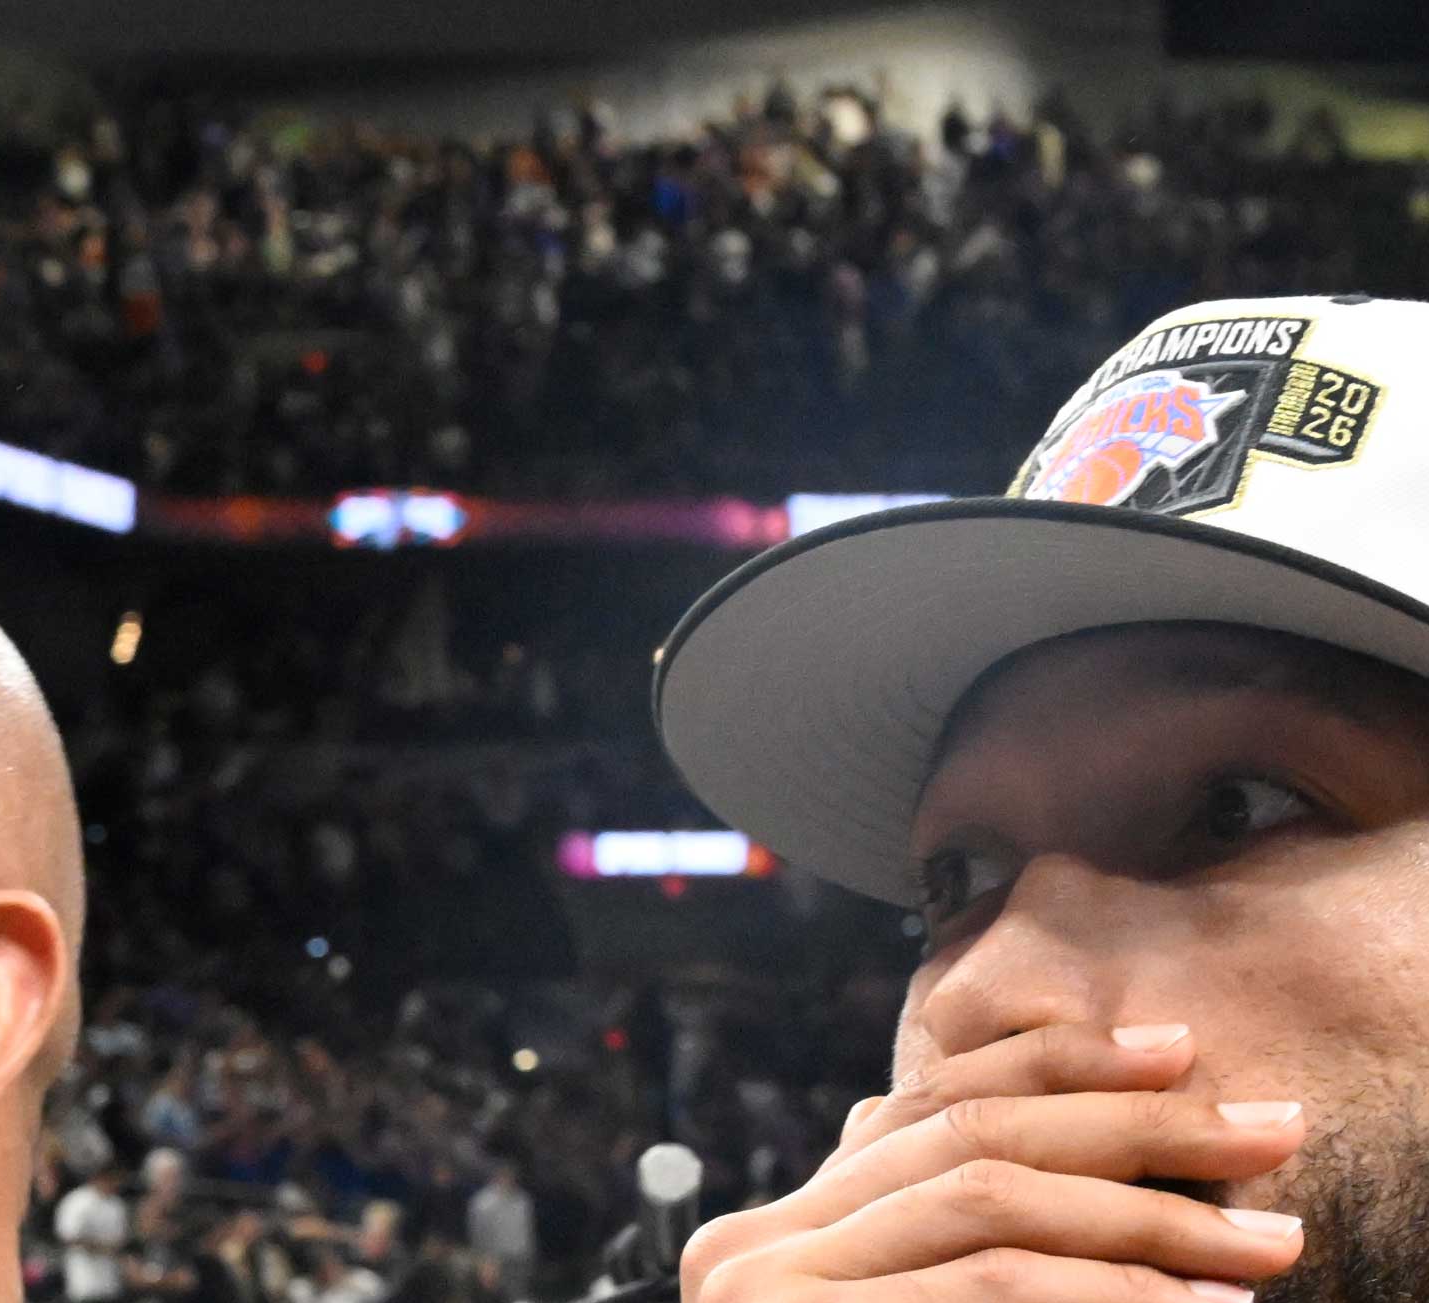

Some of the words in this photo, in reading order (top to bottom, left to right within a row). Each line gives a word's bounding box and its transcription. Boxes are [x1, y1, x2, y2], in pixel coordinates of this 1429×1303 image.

[1097, 319, 1303, 389] CHAMPIONS
[1315, 371, 1372, 415] 20
[1301, 406, 1357, 447] 26
